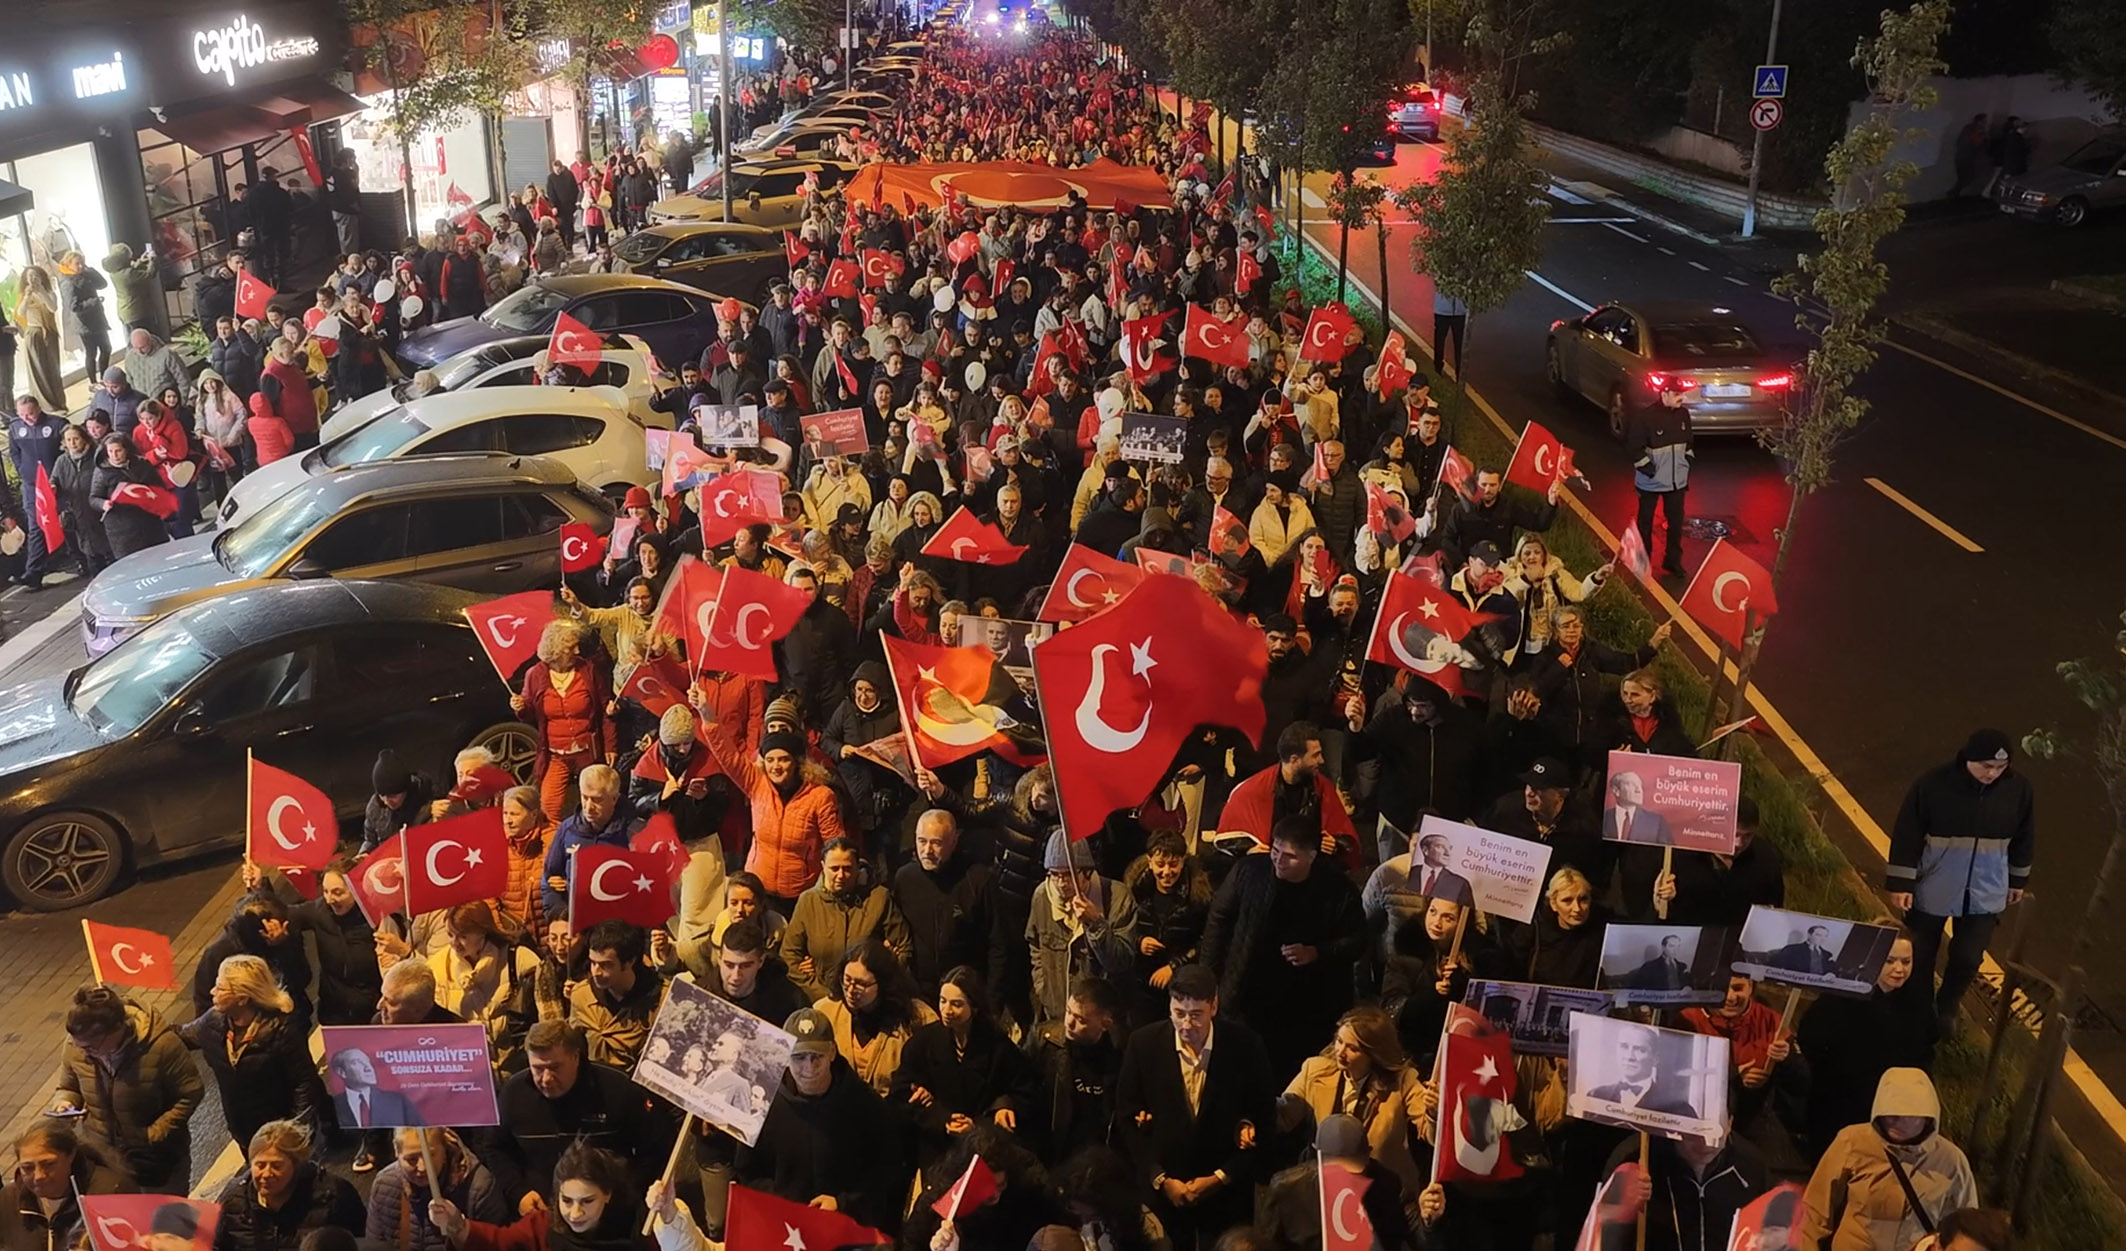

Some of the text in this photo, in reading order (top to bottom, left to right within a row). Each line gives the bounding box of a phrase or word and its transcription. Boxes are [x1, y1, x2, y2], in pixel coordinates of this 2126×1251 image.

[194, 14, 266, 87] capito
[72, 51, 127, 99] mavi
[1668, 765, 1719, 781] Benim en
[1656, 778, 1728, 797] büyük eserim
[1653, 793, 1729, 812] Cumhuriyettir.
[1480, 837, 1528, 858] Benim en
[1466, 847, 1536, 873] büyük eserim
[1460, 858, 1534, 886] Cumhuriyettir.
[391, 1065, 432, 1075] SONSUZA
[1605, 1104, 1648, 1120] Cumhuriyet
